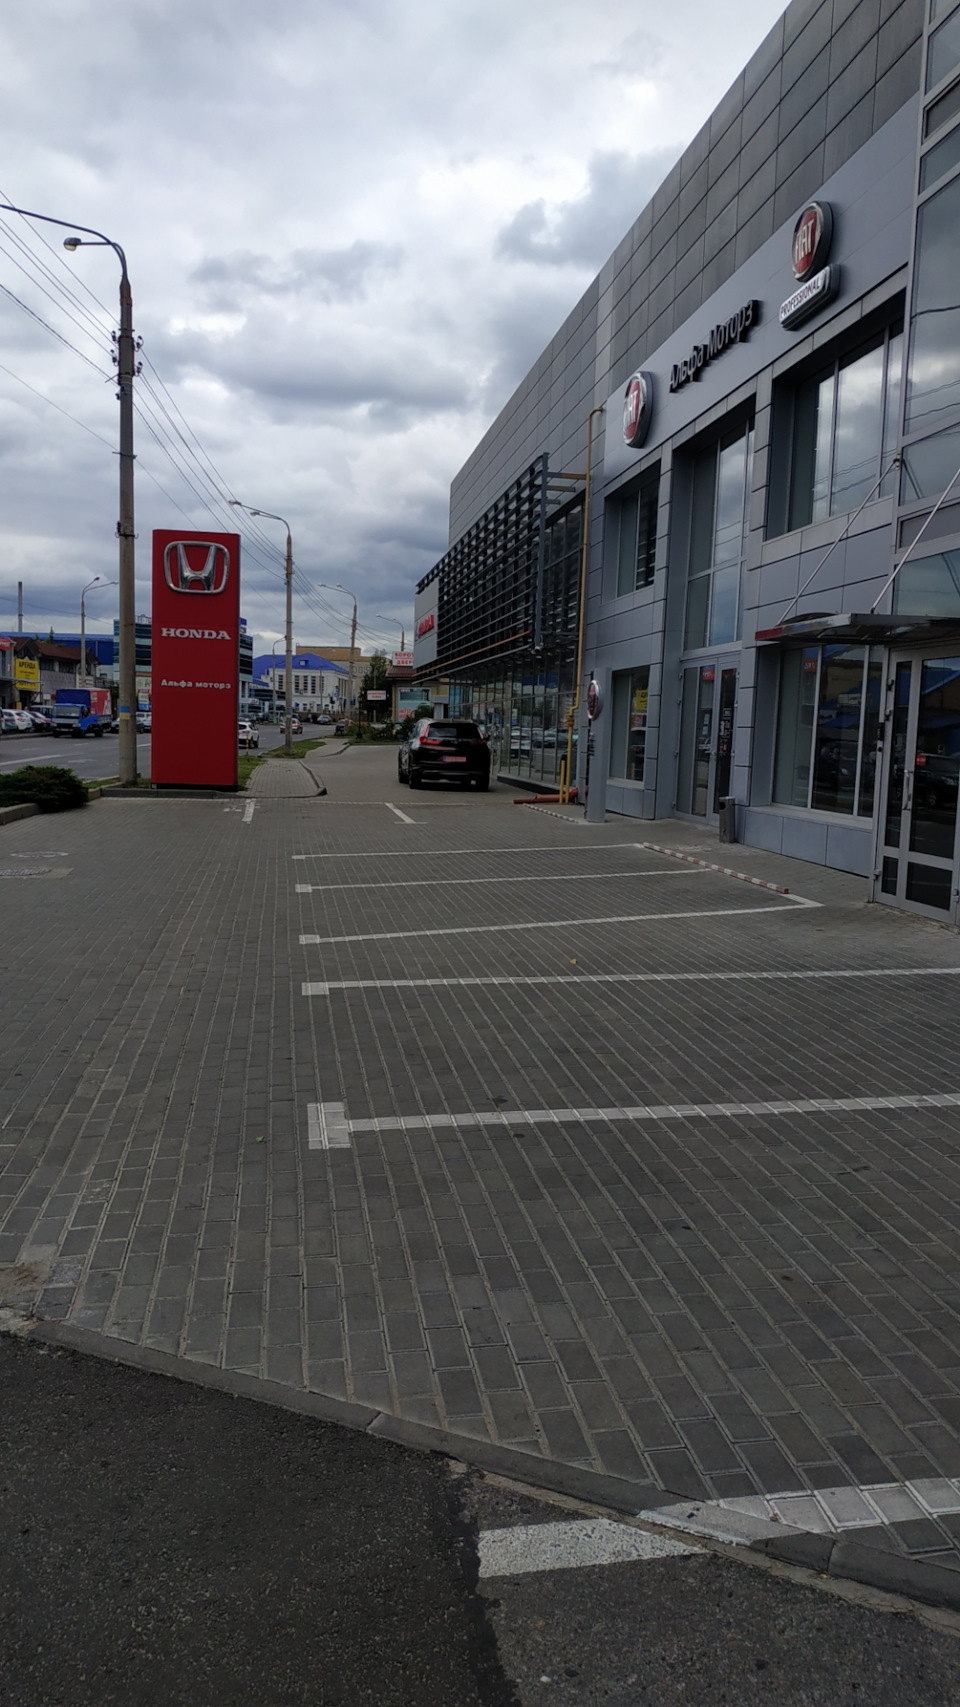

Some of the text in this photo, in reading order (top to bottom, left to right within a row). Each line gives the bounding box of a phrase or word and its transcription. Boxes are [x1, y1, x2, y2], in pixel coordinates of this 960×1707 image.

[795, 218, 815, 261] FIAT
[780, 277, 820, 319] PROFESSIONAL
[669, 299, 756, 391] Альфа Моторз
[161, 627, 231, 640] HONDA
[161, 678, 193, 688] Альфа
